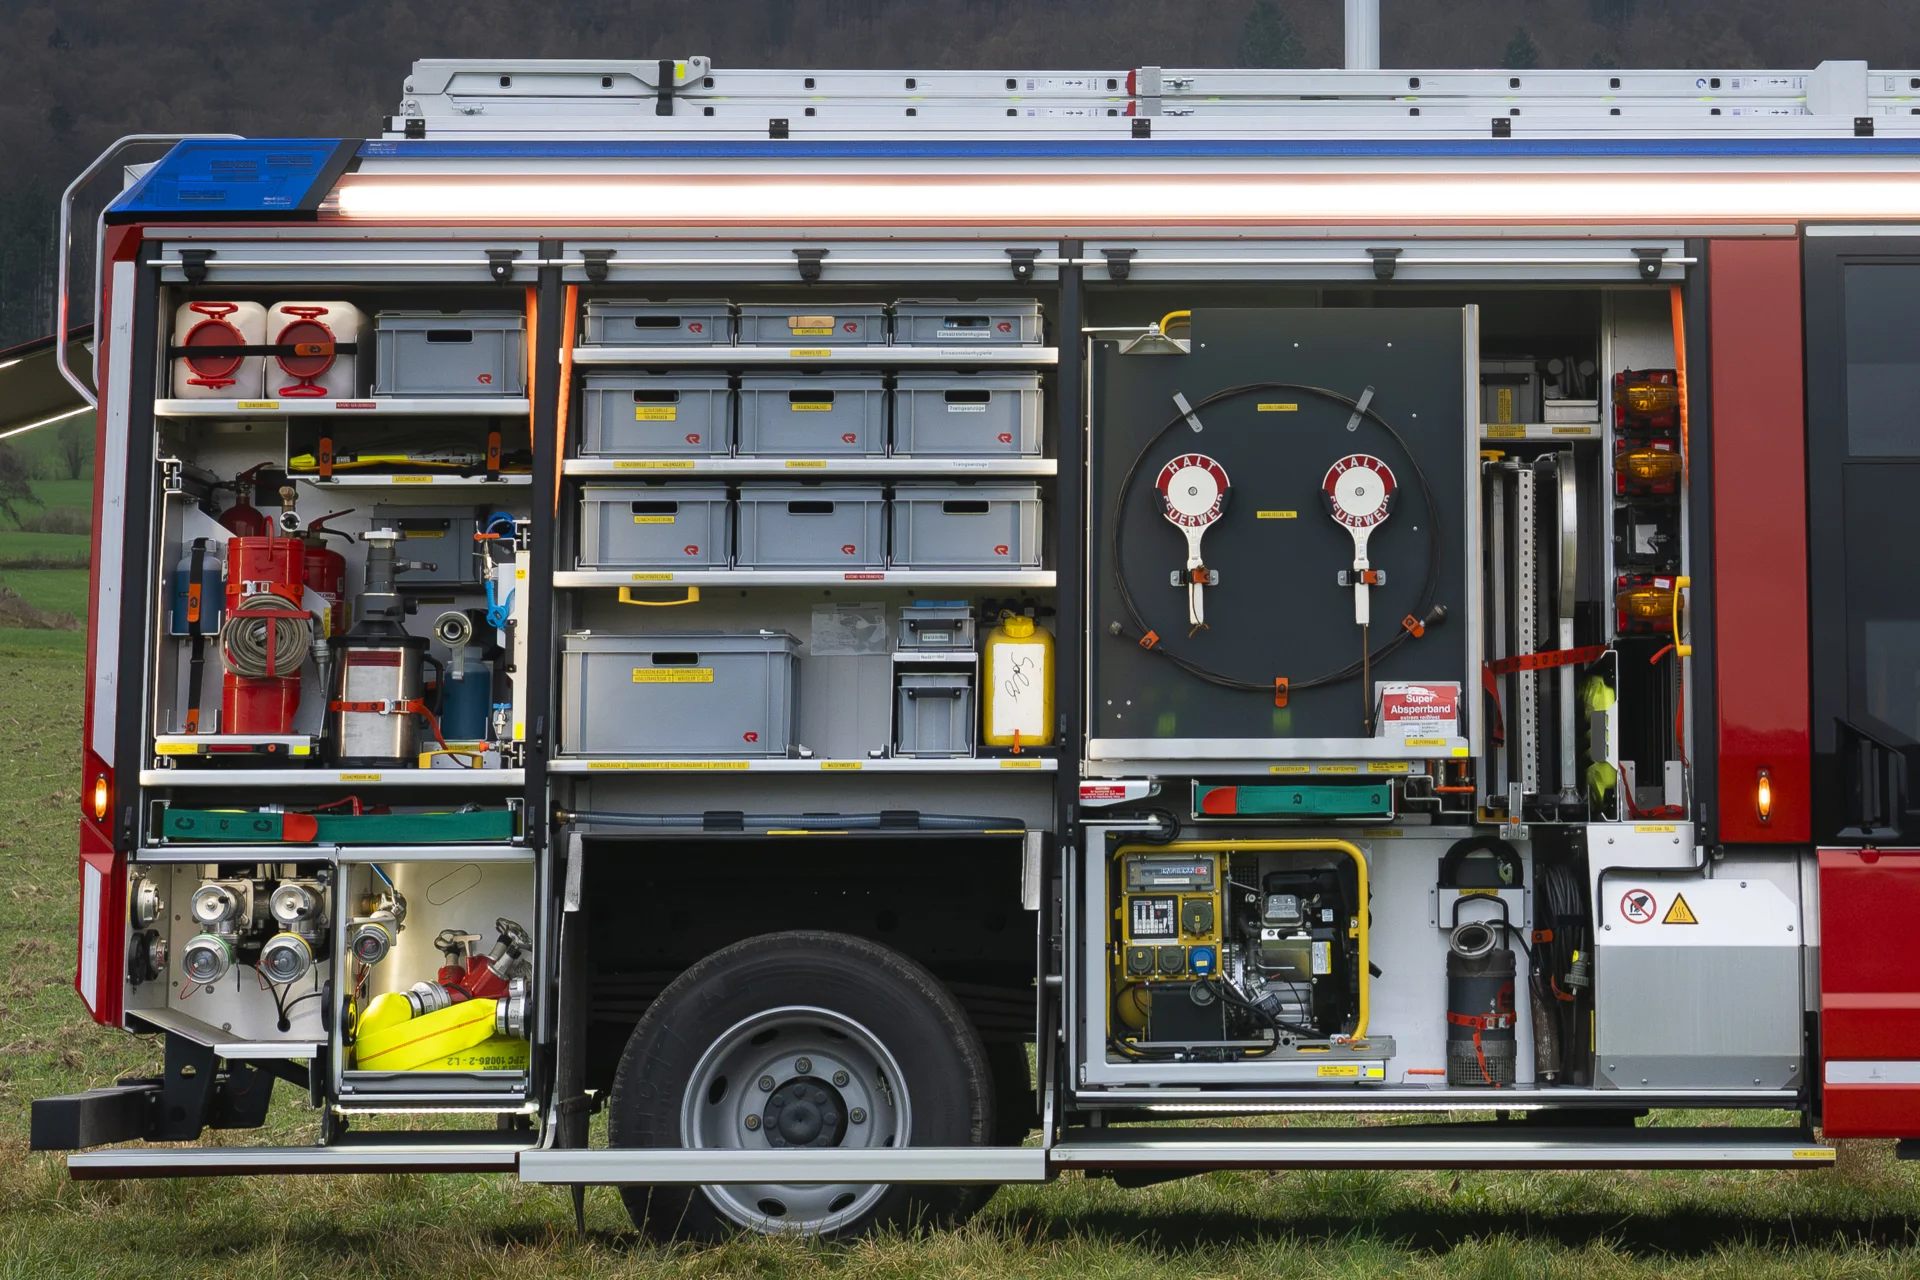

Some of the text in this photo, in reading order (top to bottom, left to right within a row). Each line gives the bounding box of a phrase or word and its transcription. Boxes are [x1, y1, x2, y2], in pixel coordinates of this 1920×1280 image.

[1167, 456, 1216, 474] HALT
[1334, 456, 1384, 474] HALT
[1405, 694, 1433, 704] Super
[1391, 704, 1450, 715] Absperrband
[447, 1057, 460, 1066] L2
[508, 1055, 525, 1065] ZPC
